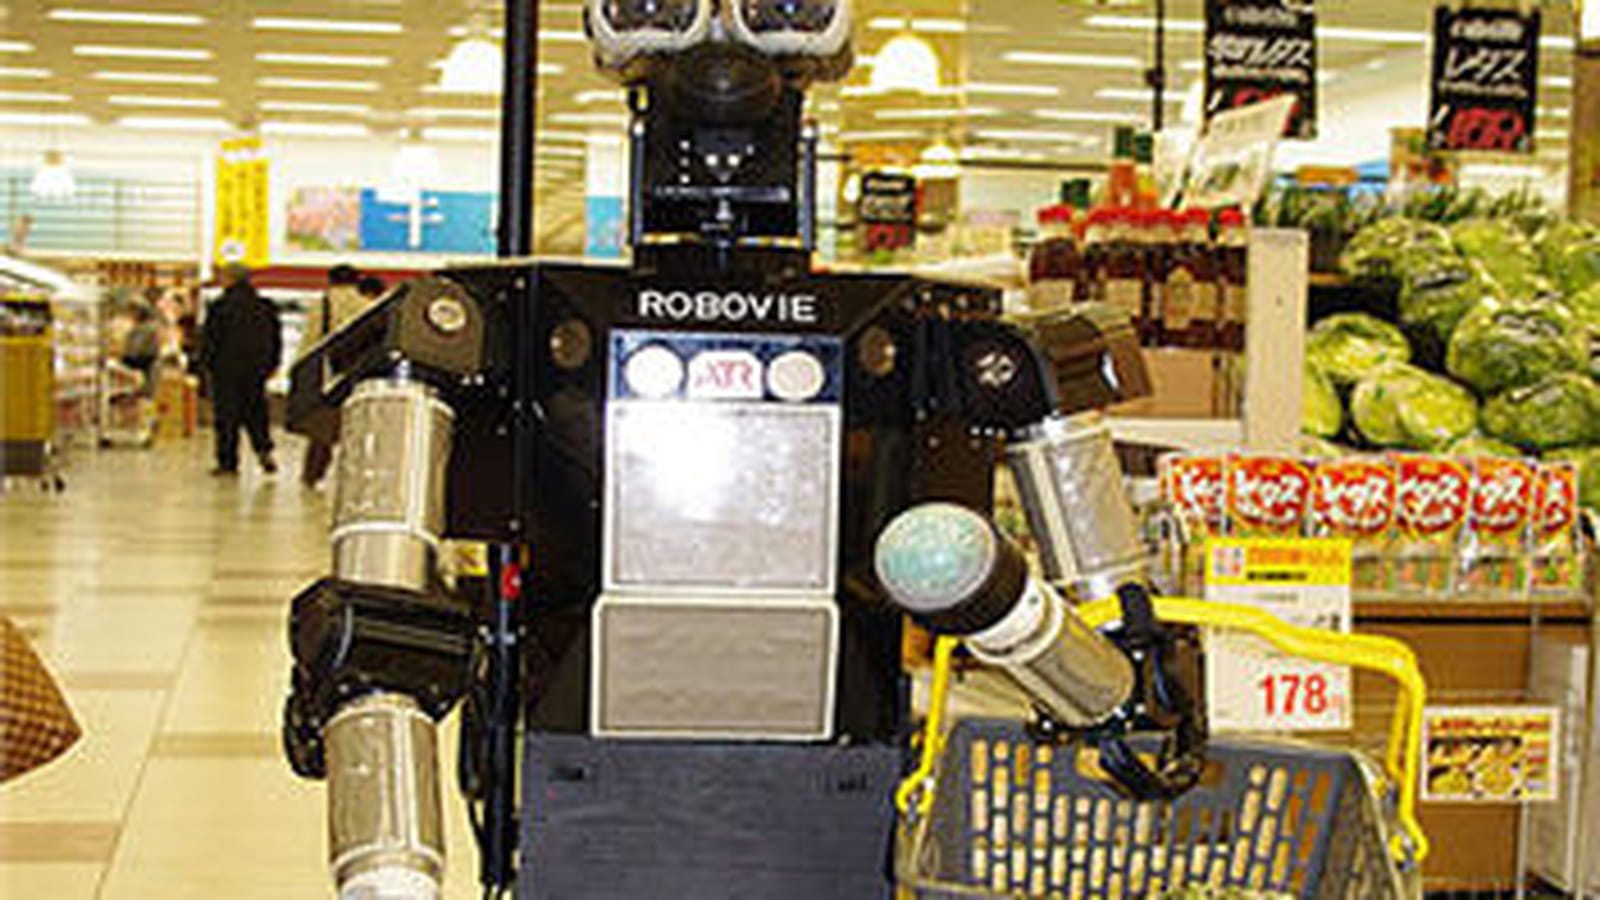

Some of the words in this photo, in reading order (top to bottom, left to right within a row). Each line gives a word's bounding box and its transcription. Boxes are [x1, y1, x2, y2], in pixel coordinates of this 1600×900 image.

[1446, 47, 1528, 82] レタス
[638, 290, 817, 322] ROBOVIE
[693, 359, 754, 391] ATR
[1259, 673, 1328, 716] 178
